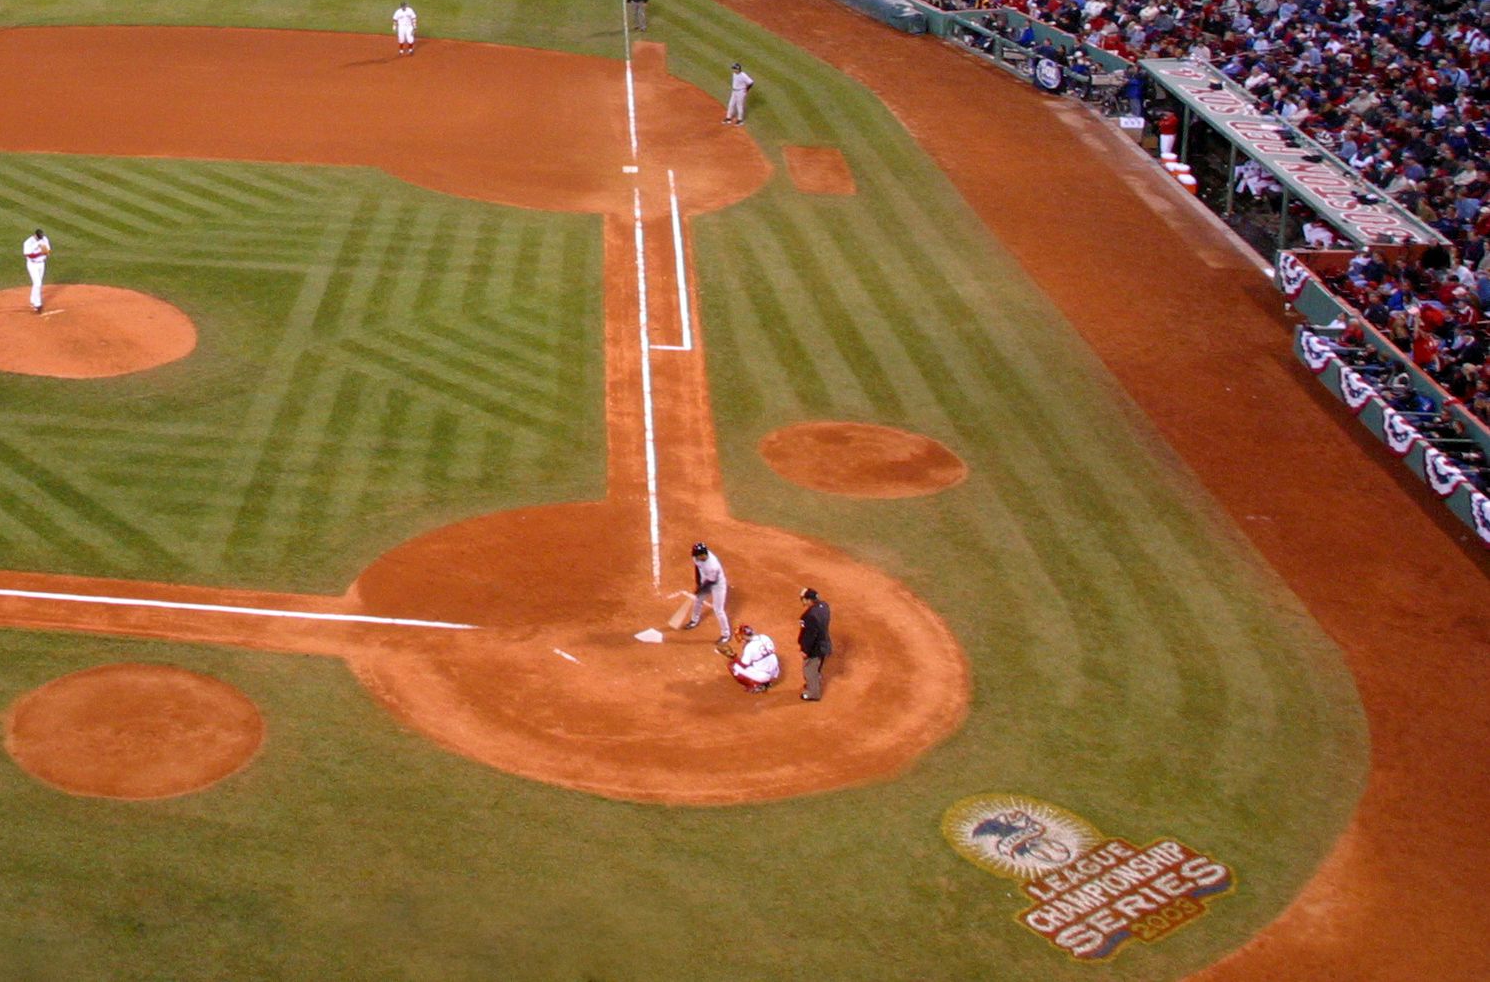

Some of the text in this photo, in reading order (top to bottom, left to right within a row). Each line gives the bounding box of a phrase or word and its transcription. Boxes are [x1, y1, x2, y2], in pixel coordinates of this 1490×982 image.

[1026, 841, 1188, 933] CHAMPIONSHIP
[1027, 841, 1135, 900] LEAGUE
[1055, 857, 1228, 957] SERIES
[1132, 897, 1198, 939] 2003
